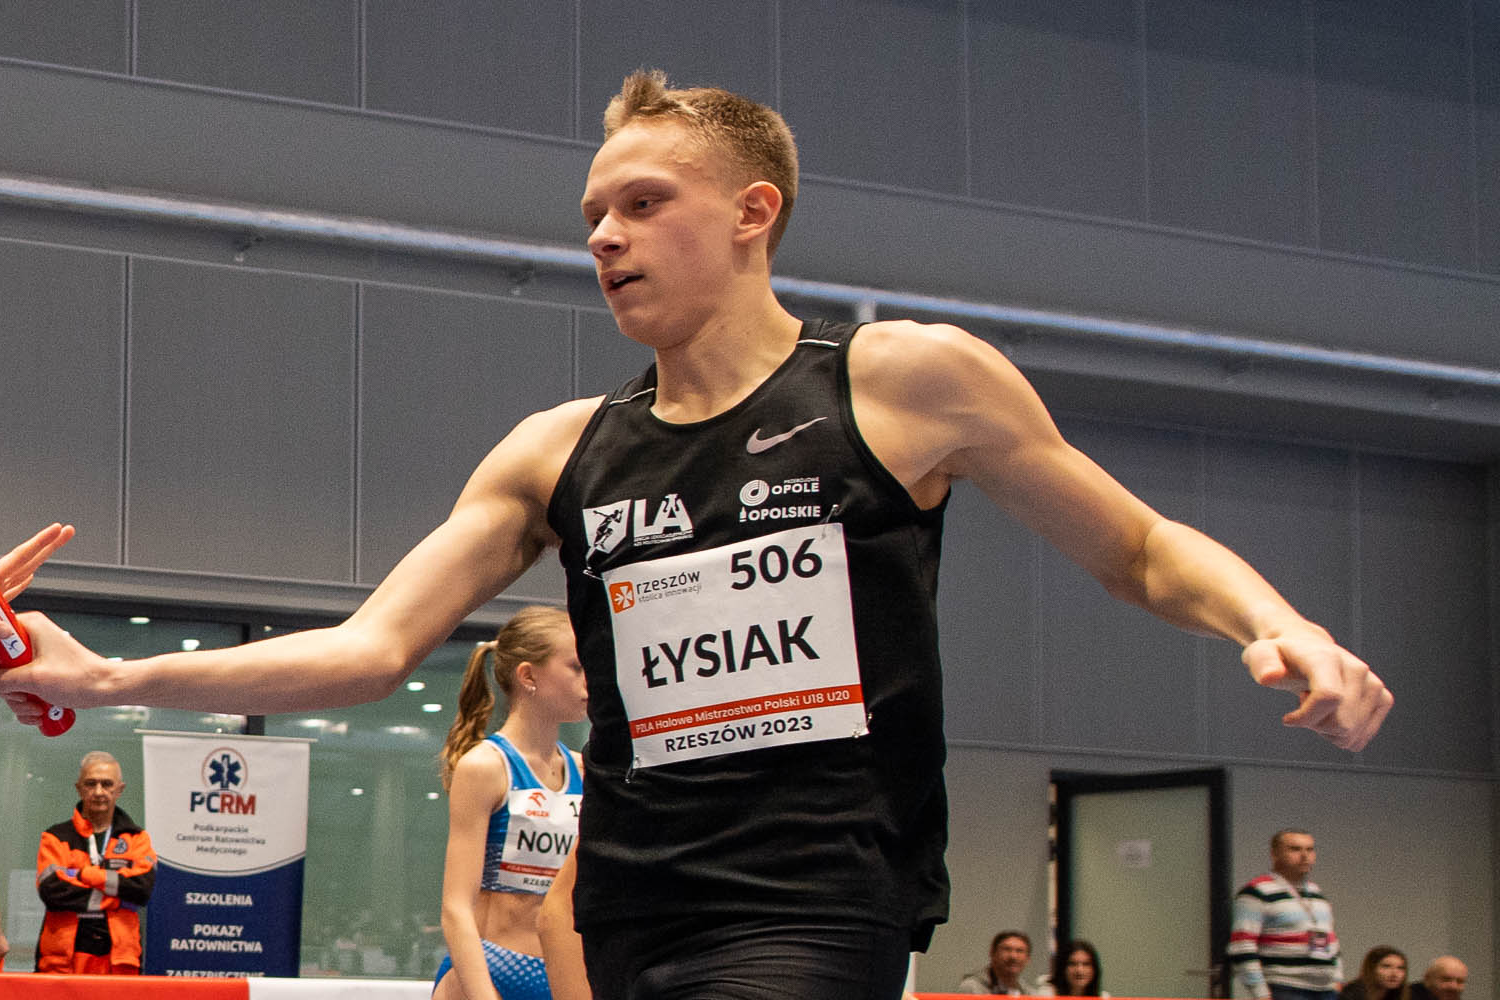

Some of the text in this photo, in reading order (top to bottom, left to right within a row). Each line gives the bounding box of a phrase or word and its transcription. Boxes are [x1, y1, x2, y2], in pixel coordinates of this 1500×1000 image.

[771, 482, 820, 495] OPOLE
[748, 505, 821, 521] OPOLSKIE
[730, 538, 823, 591] 506
[636, 571, 701, 595] rzeszów
[641, 615, 821, 689] ŁYSIAK
[635, 689, 851, 734] PZLA Halowe Mistrzostwa Polski U18 U20
[664, 715, 813, 753] RZESZÓW 2023
[190, 791, 257, 816] PCRM
[176, 833, 266, 845] Centrum Ratownictwa
[516, 828, 573, 856] NOW
[196, 846, 248, 856] Medycznego
[523, 877, 551, 887] RZESZ
[185, 892, 253, 906] SZKOLENIA
[193, 924, 244, 937] POKAZY
[171, 938, 263, 953] RATOWNICTWA
